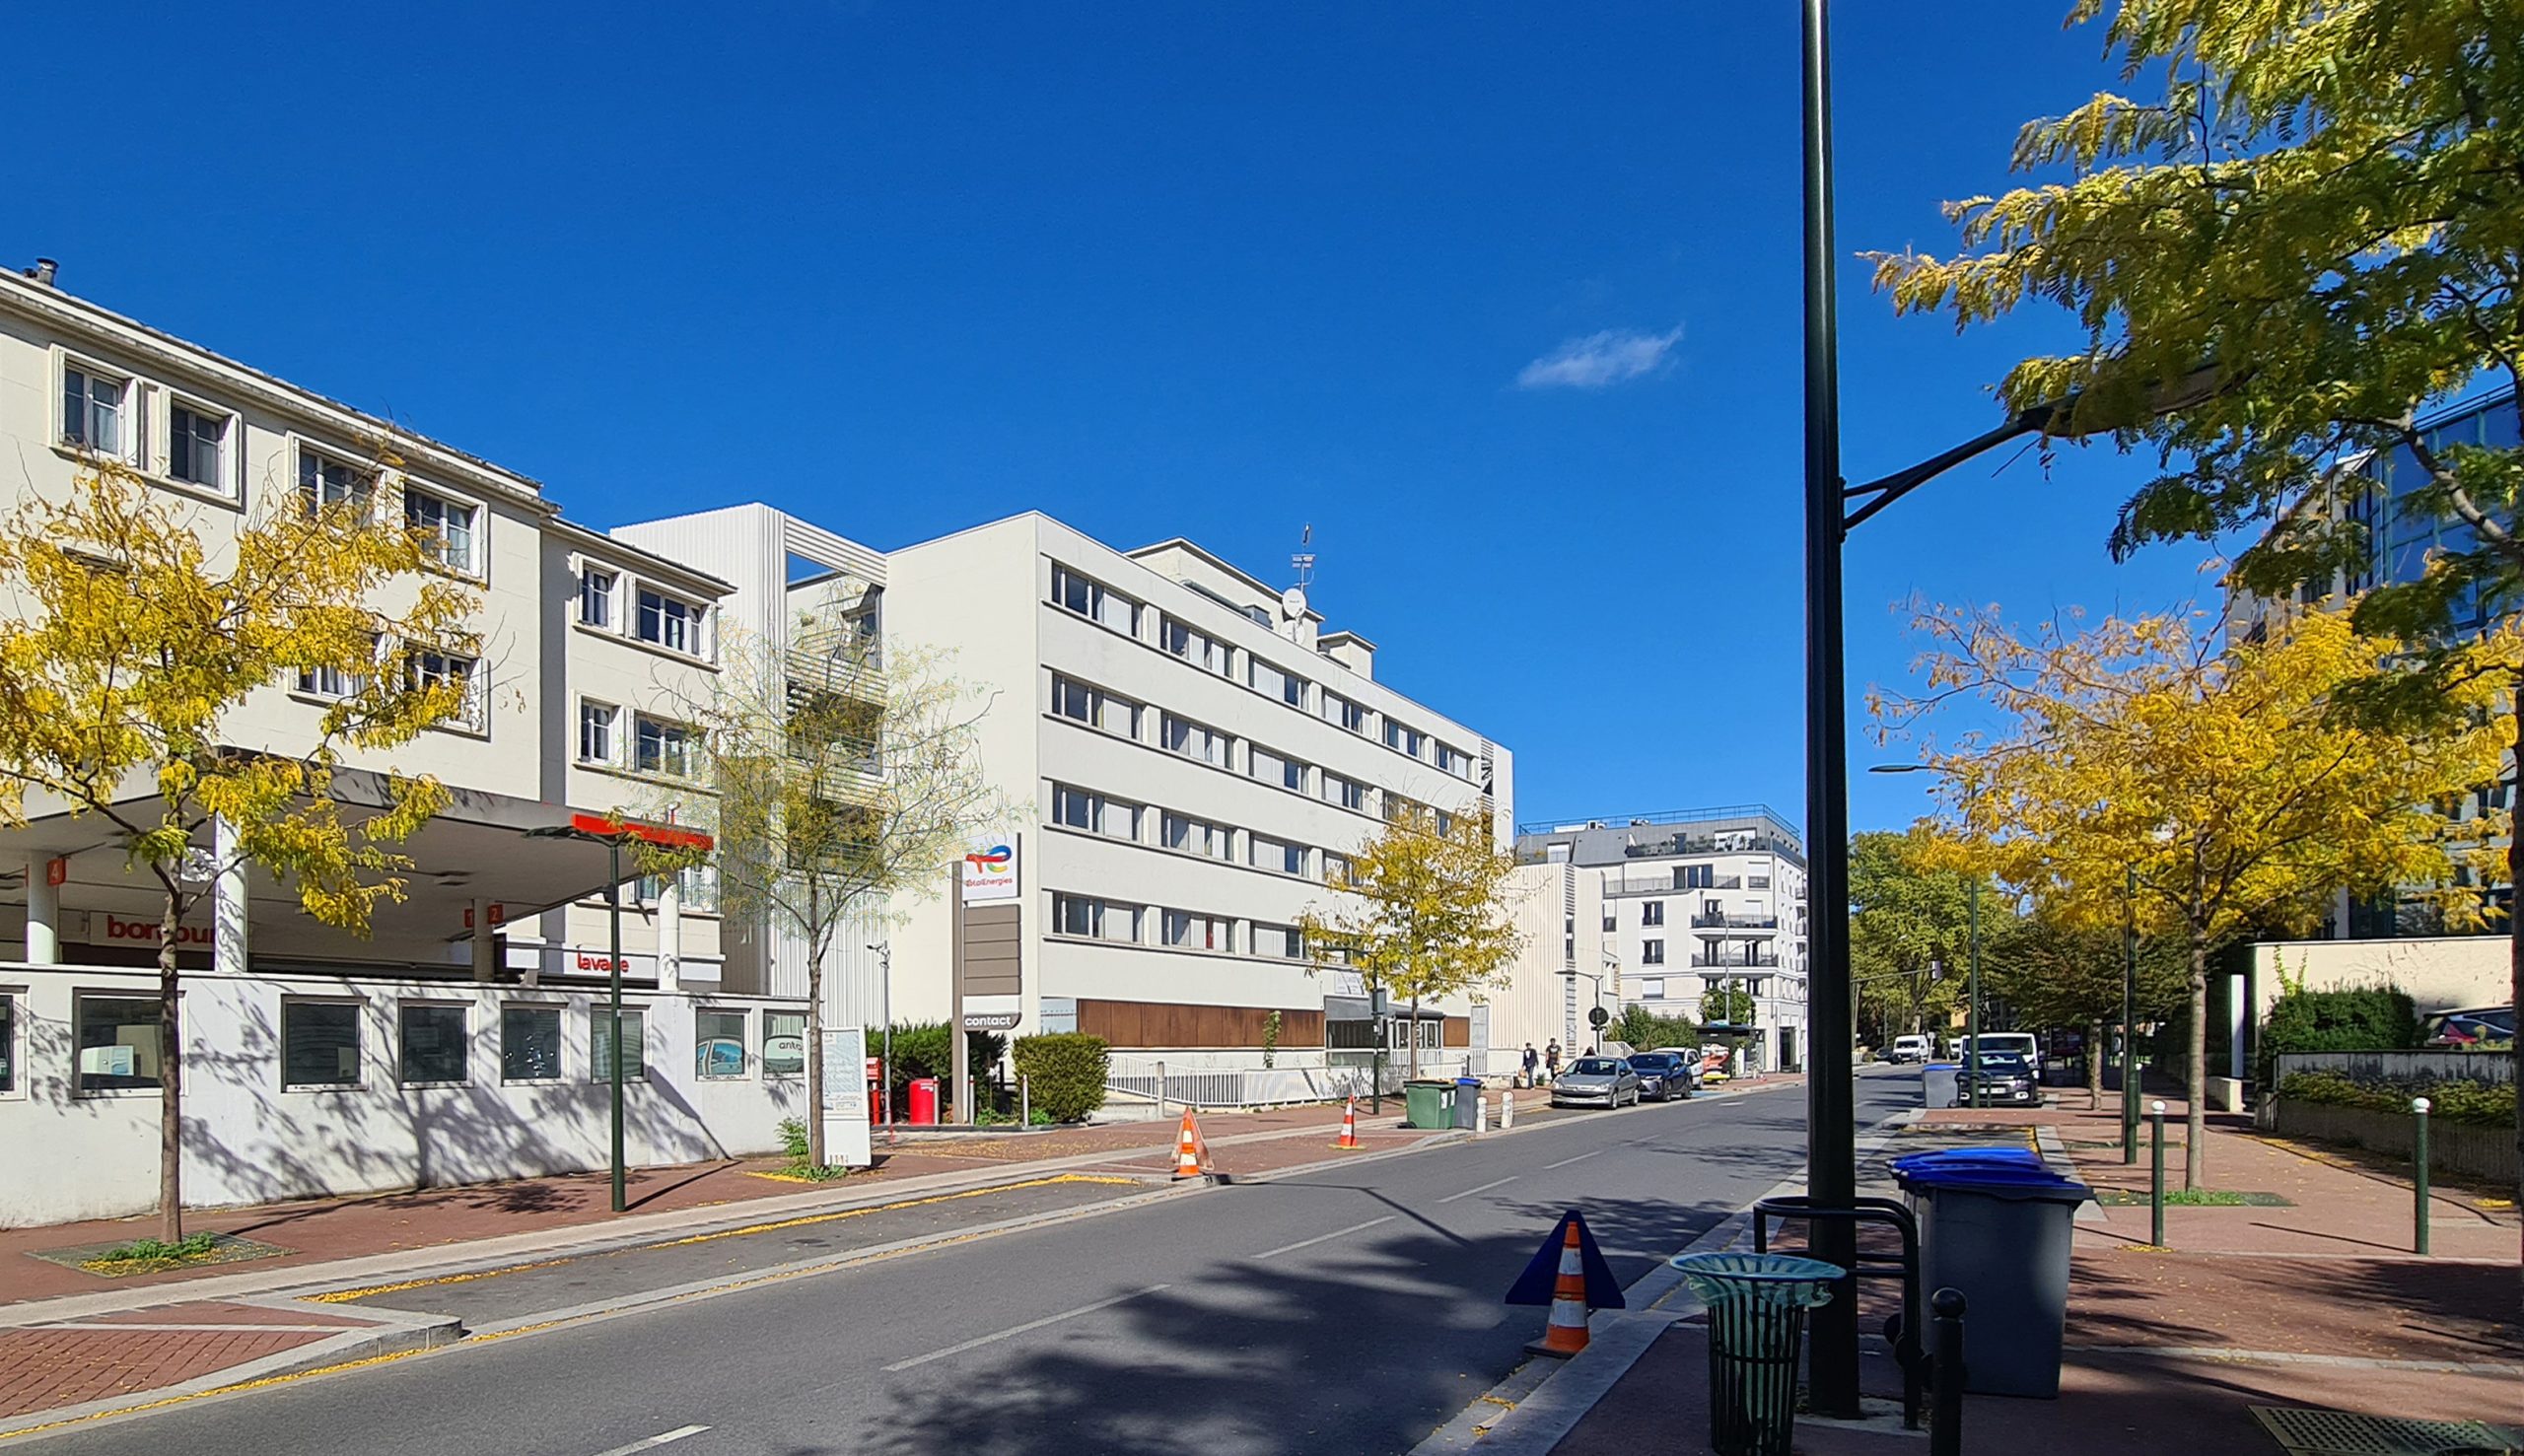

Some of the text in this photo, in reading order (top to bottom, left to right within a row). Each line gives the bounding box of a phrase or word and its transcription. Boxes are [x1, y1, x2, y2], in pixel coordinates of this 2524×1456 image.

[107, 915, 215, 943] bonour
[577, 950, 630, 973] lavae
[964, 1015, 1011, 1026] contact
